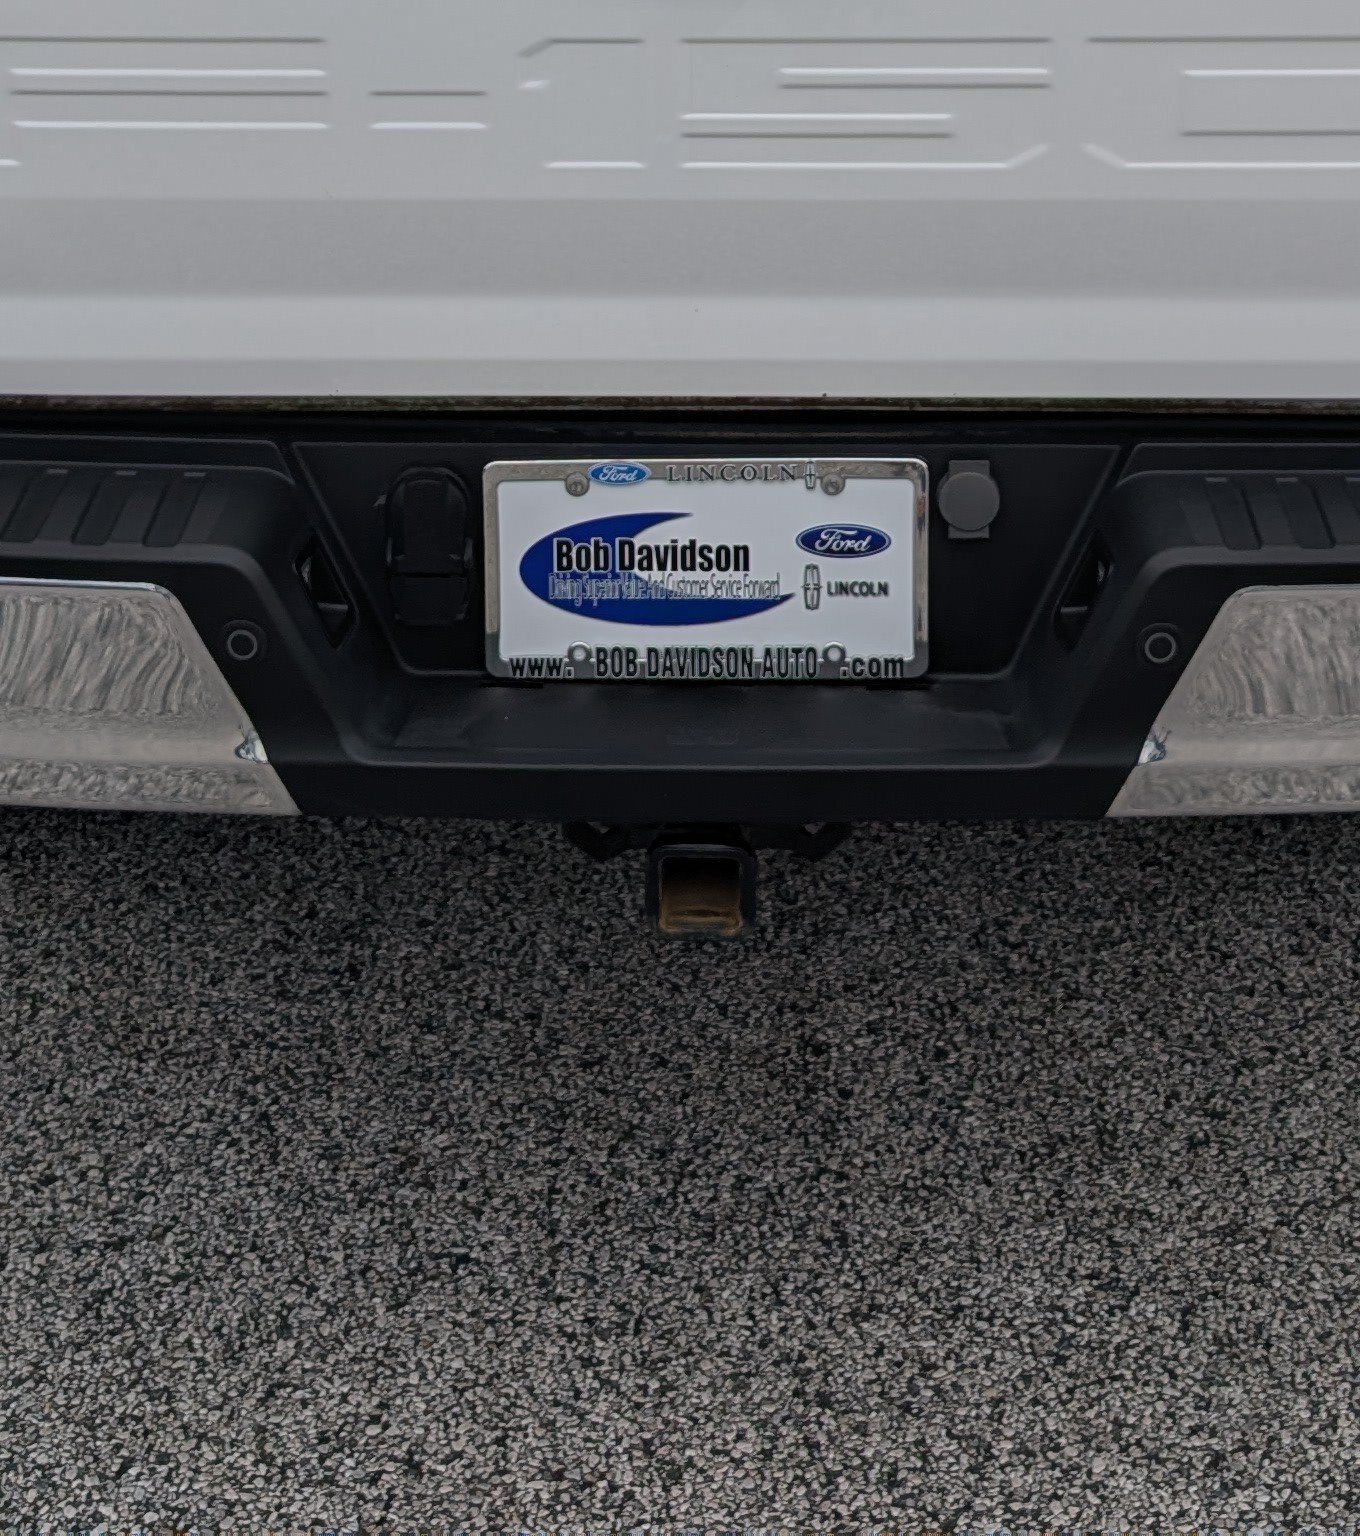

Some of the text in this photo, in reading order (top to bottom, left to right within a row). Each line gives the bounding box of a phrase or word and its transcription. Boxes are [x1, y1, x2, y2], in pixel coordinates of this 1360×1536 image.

[596, 465, 797, 483] Ford LINCOLN
[555, 538, 750, 572] Bob Davidson
[827, 581, 889, 597] LINCOLN
[596, 646, 637, 679] BOB
[647, 646, 759, 679] DAVIDSON
[762, 646, 818, 679] AUTO
